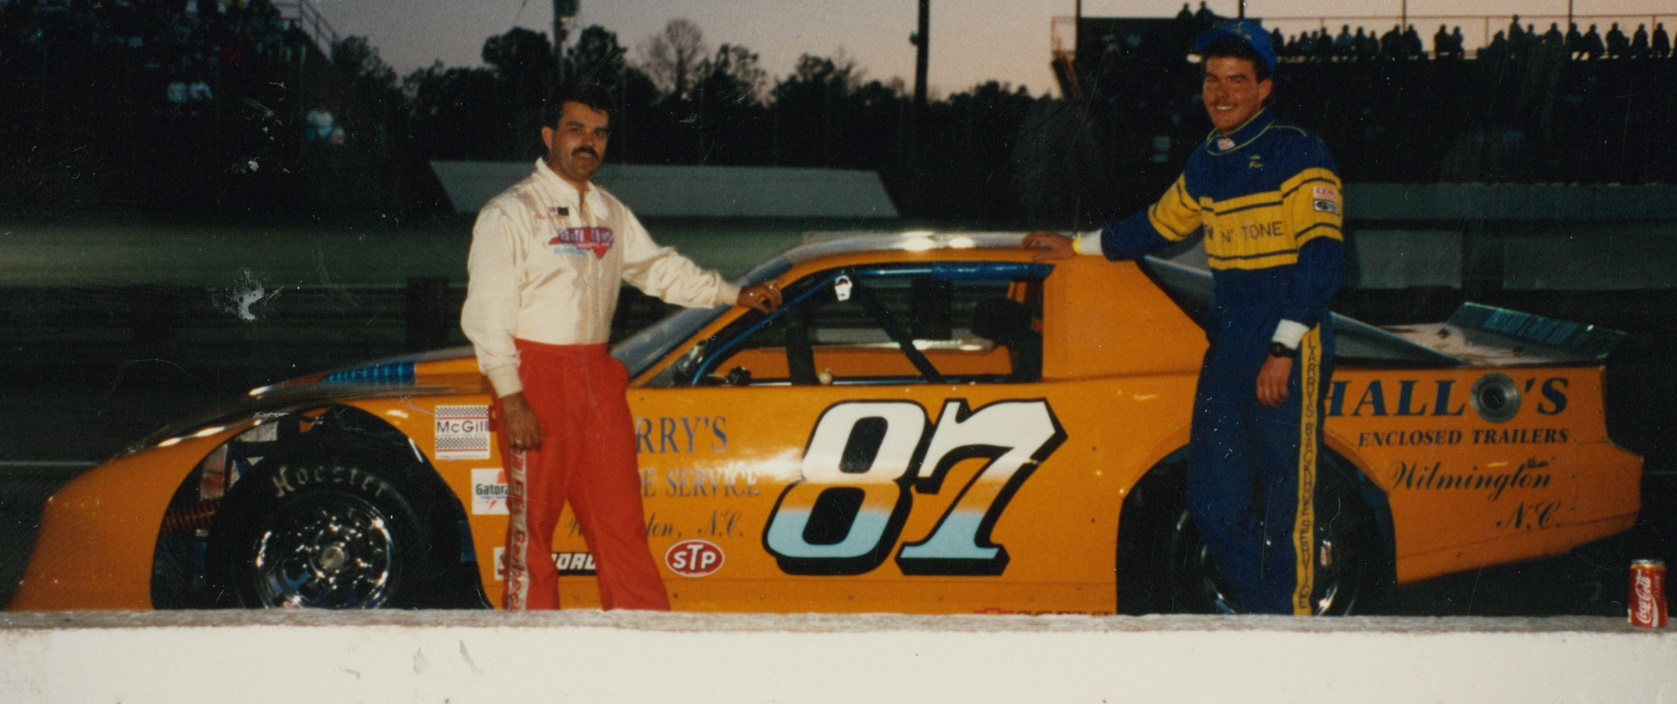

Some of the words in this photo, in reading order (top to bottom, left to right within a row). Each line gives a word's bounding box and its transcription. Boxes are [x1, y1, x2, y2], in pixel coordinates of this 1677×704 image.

[1241, 221, 1285, 241] TONE
[436, 420, 488, 433] McGill
[635, 415, 728, 455] RRY'S
[1358, 430, 1463, 447] ENCLOSED
[1472, 428, 1569, 446] TRAILERS
[475, 484, 510, 496] Gatora
[665, 467, 760, 498] SERVICE
[762, 397, 1068, 577] 87
[1392, 461, 1551, 501] Wilmington
[672, 544, 717, 571] STP
